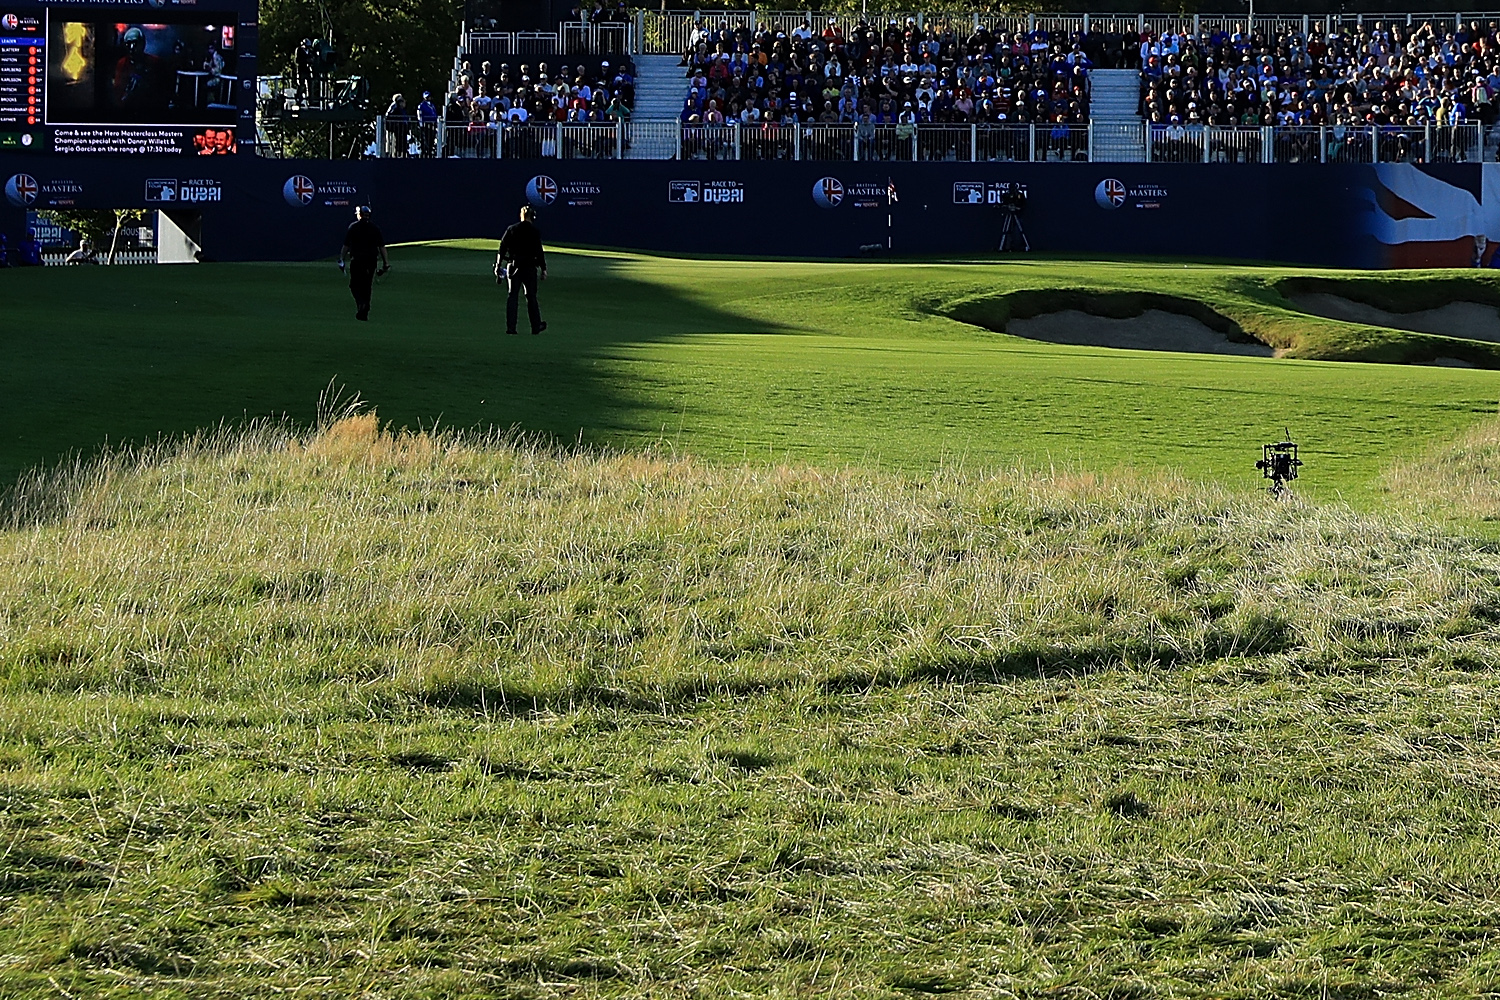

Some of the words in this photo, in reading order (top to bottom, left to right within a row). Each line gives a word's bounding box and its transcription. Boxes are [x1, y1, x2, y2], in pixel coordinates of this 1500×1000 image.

[181, 187, 221, 202] DUBAI
[704, 189, 744, 203] DUBAI
[121, 226, 139, 236] HOUS
